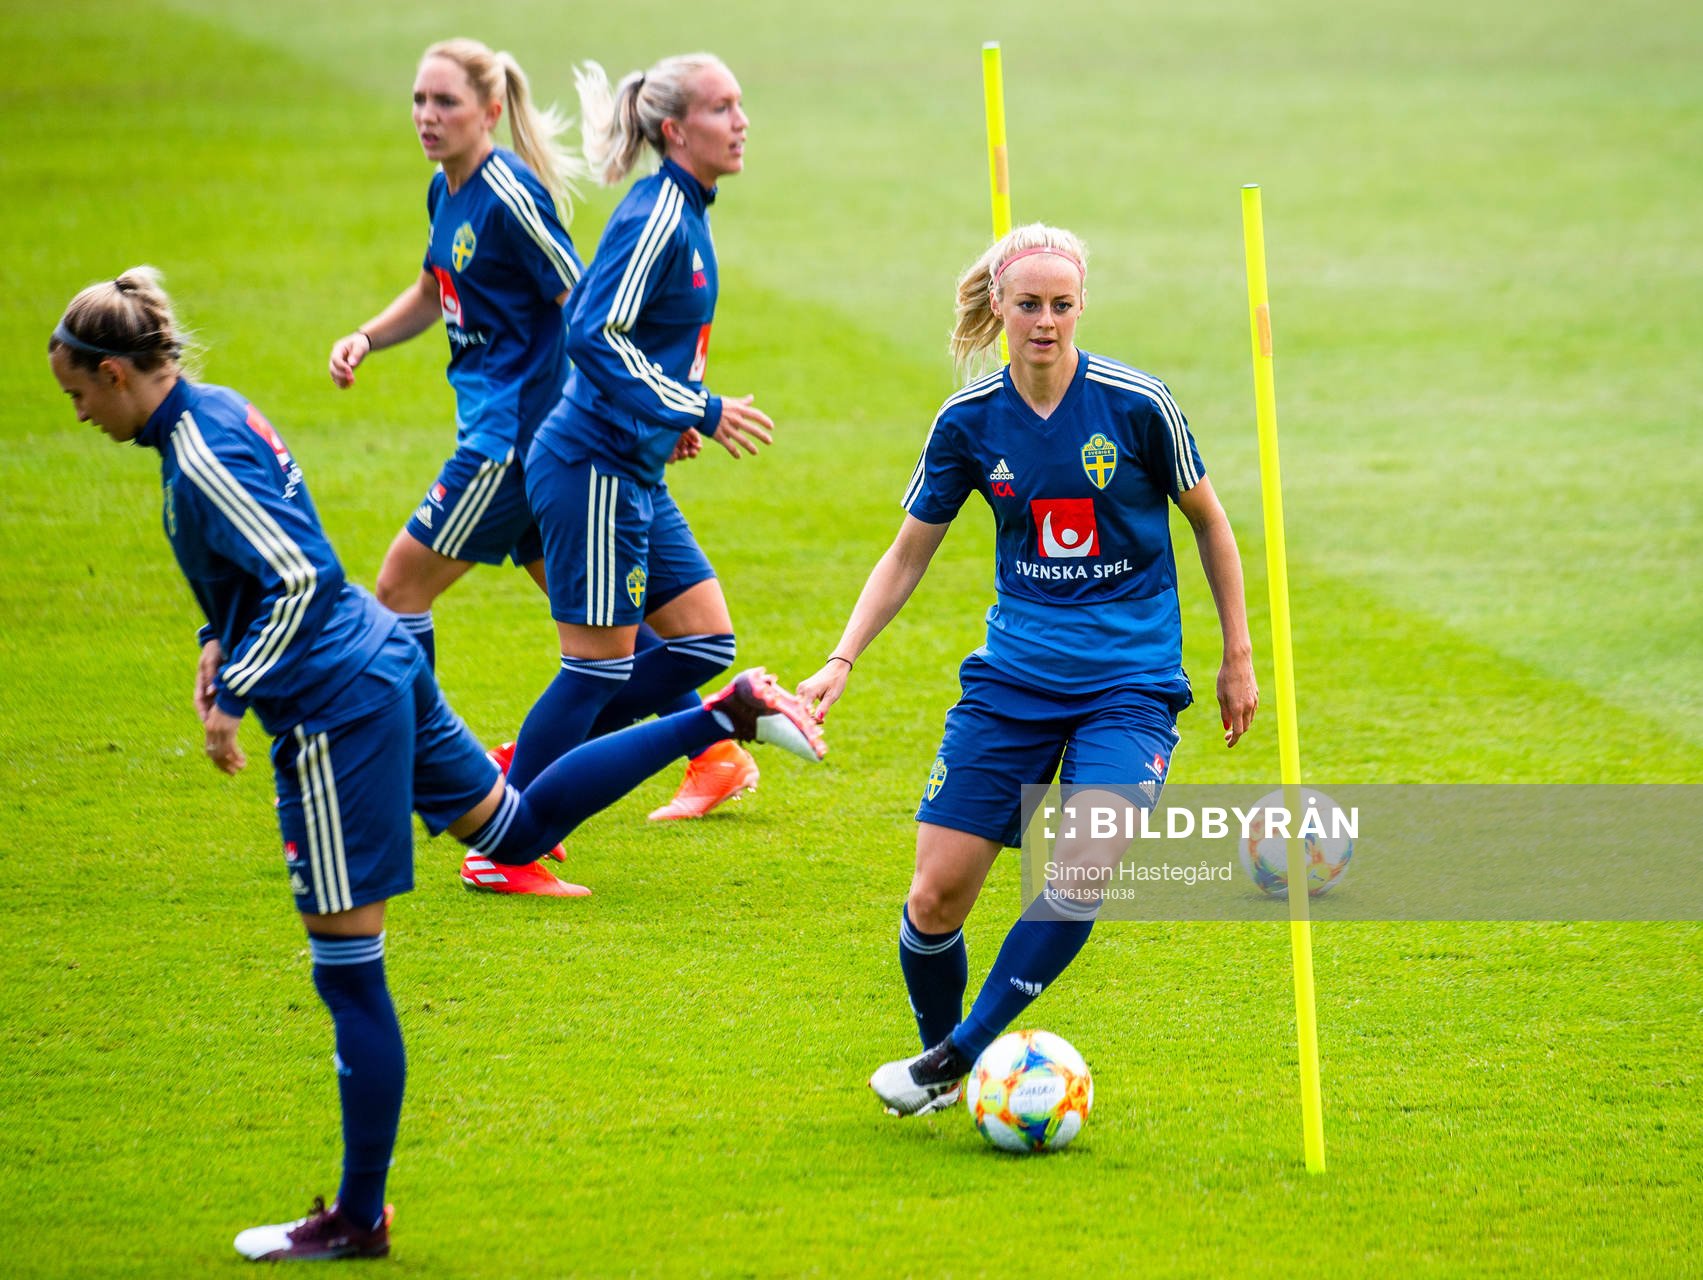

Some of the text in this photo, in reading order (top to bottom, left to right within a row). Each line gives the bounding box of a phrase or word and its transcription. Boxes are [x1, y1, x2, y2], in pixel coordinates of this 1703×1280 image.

[990, 473, 1014, 481] adidas
[991, 481, 1016, 497] ICA
[1016, 558, 1133, 580] SVENSKA SPEL
